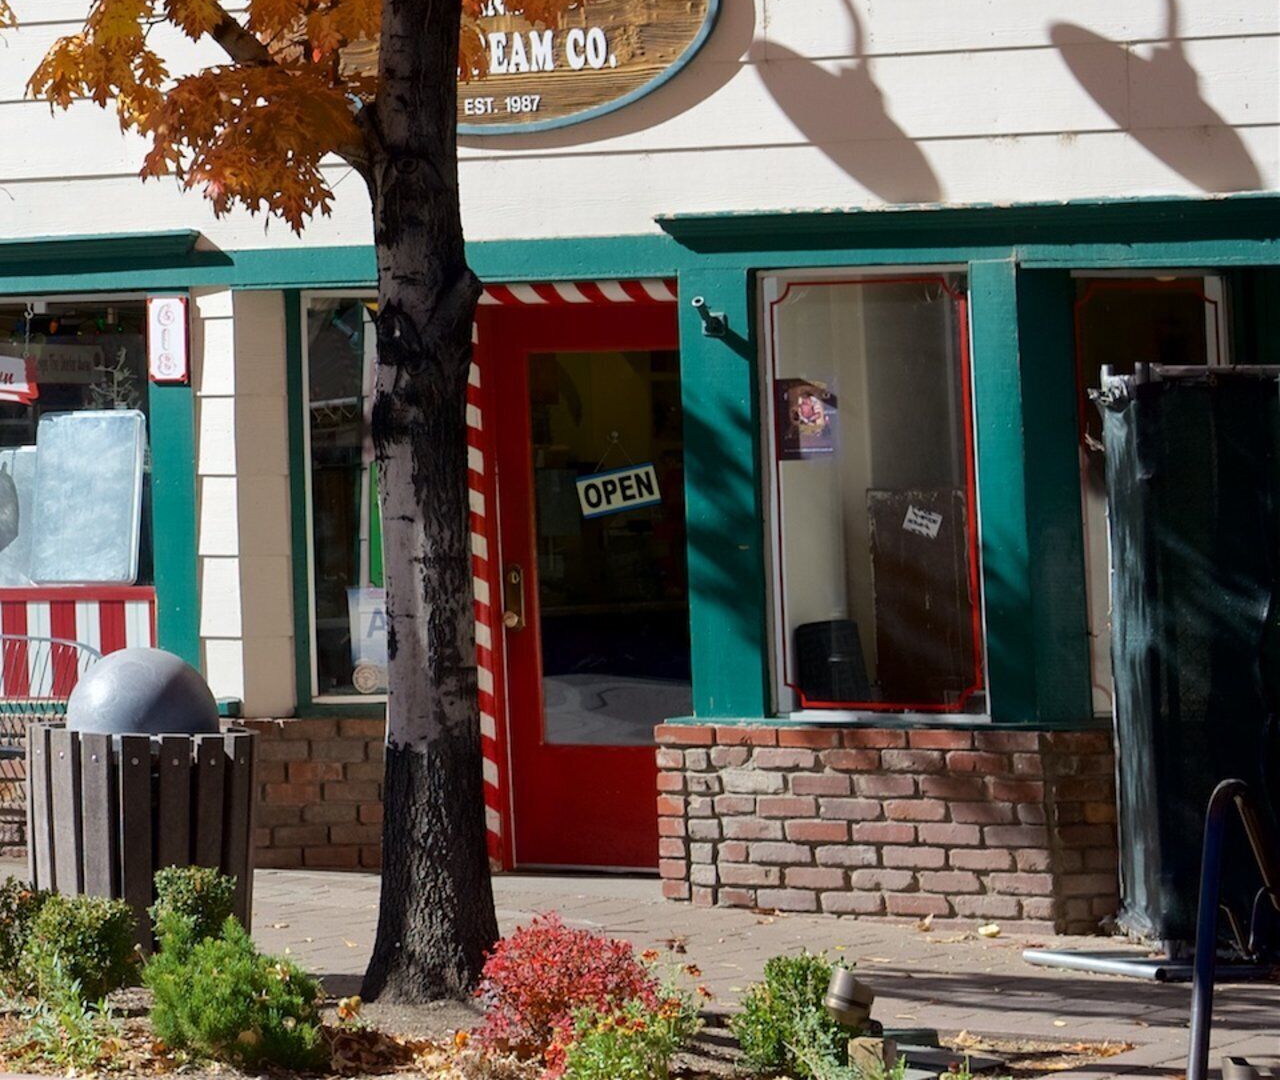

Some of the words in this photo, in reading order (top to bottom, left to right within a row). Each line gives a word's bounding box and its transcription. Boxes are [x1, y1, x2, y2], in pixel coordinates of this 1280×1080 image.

[565, 26, 618, 71] CO.
[464, 98, 499, 116] EST.
[504, 95, 541, 114] 1987
[584, 471, 654, 508] OPEN
